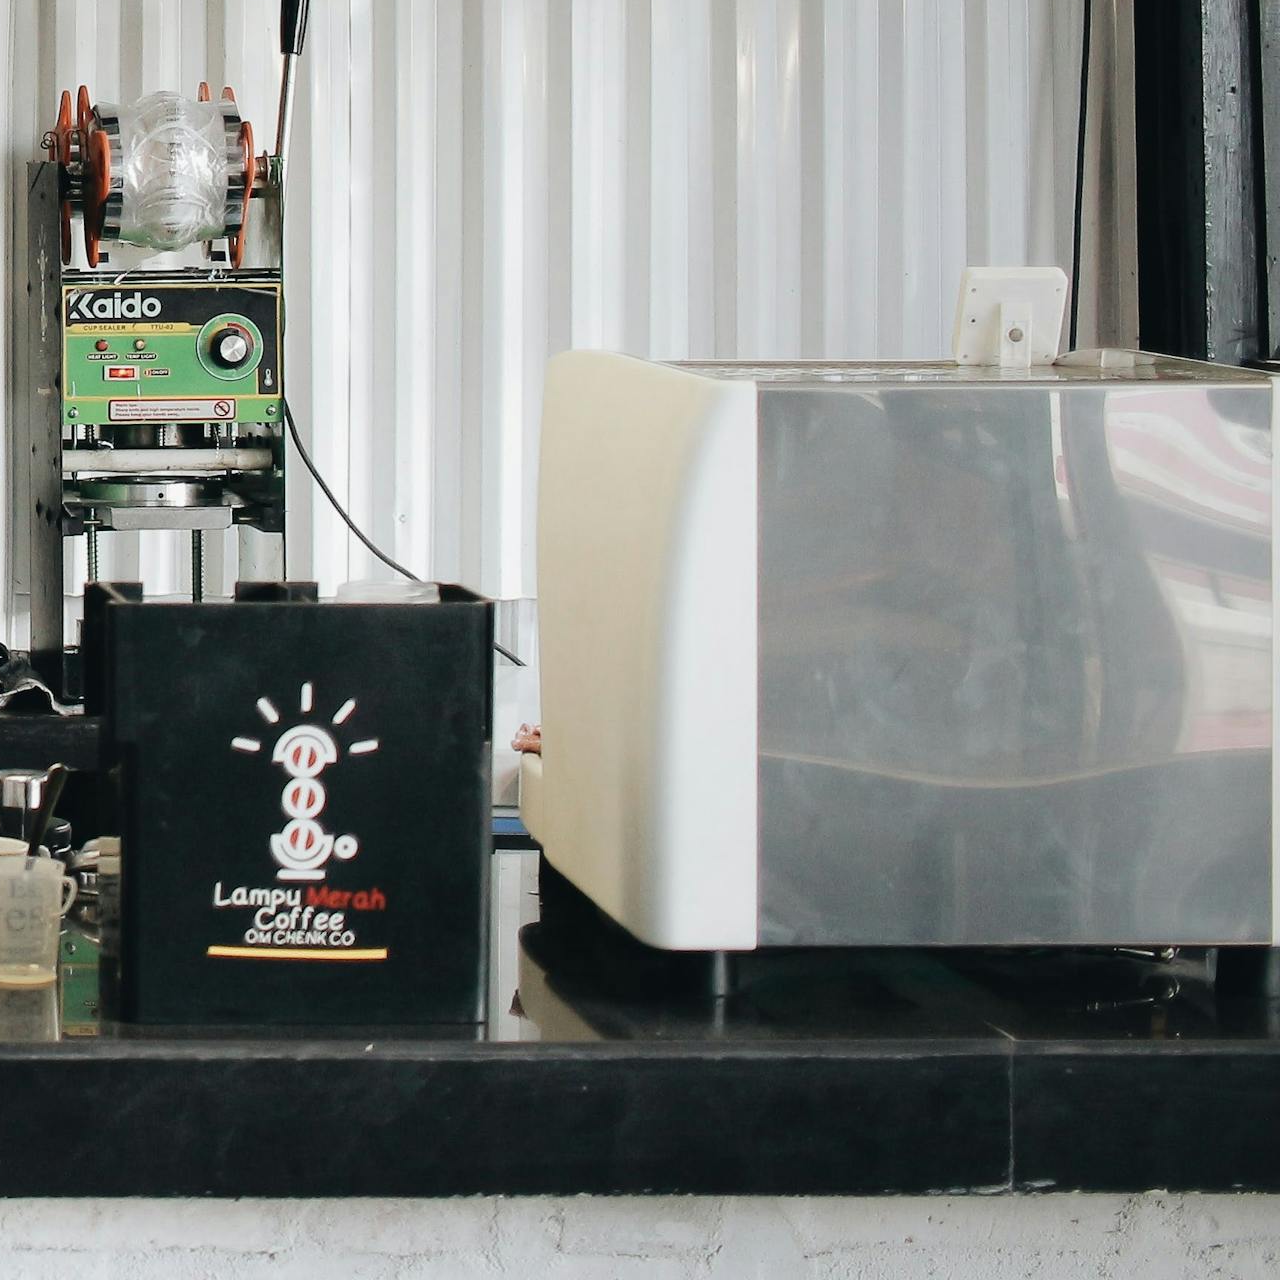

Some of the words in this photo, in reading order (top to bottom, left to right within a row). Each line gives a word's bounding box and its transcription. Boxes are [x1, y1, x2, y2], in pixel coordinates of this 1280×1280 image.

[69, 291, 162, 319] Kaido
[213, 881, 302, 915] Lampu
[305, 885, 386, 910] Merah
[254, 905, 345, 931] Coffee
[244, 928, 271, 945] OM
[272, 930, 327, 945] CHENK
[329, 930, 356, 946] CO
